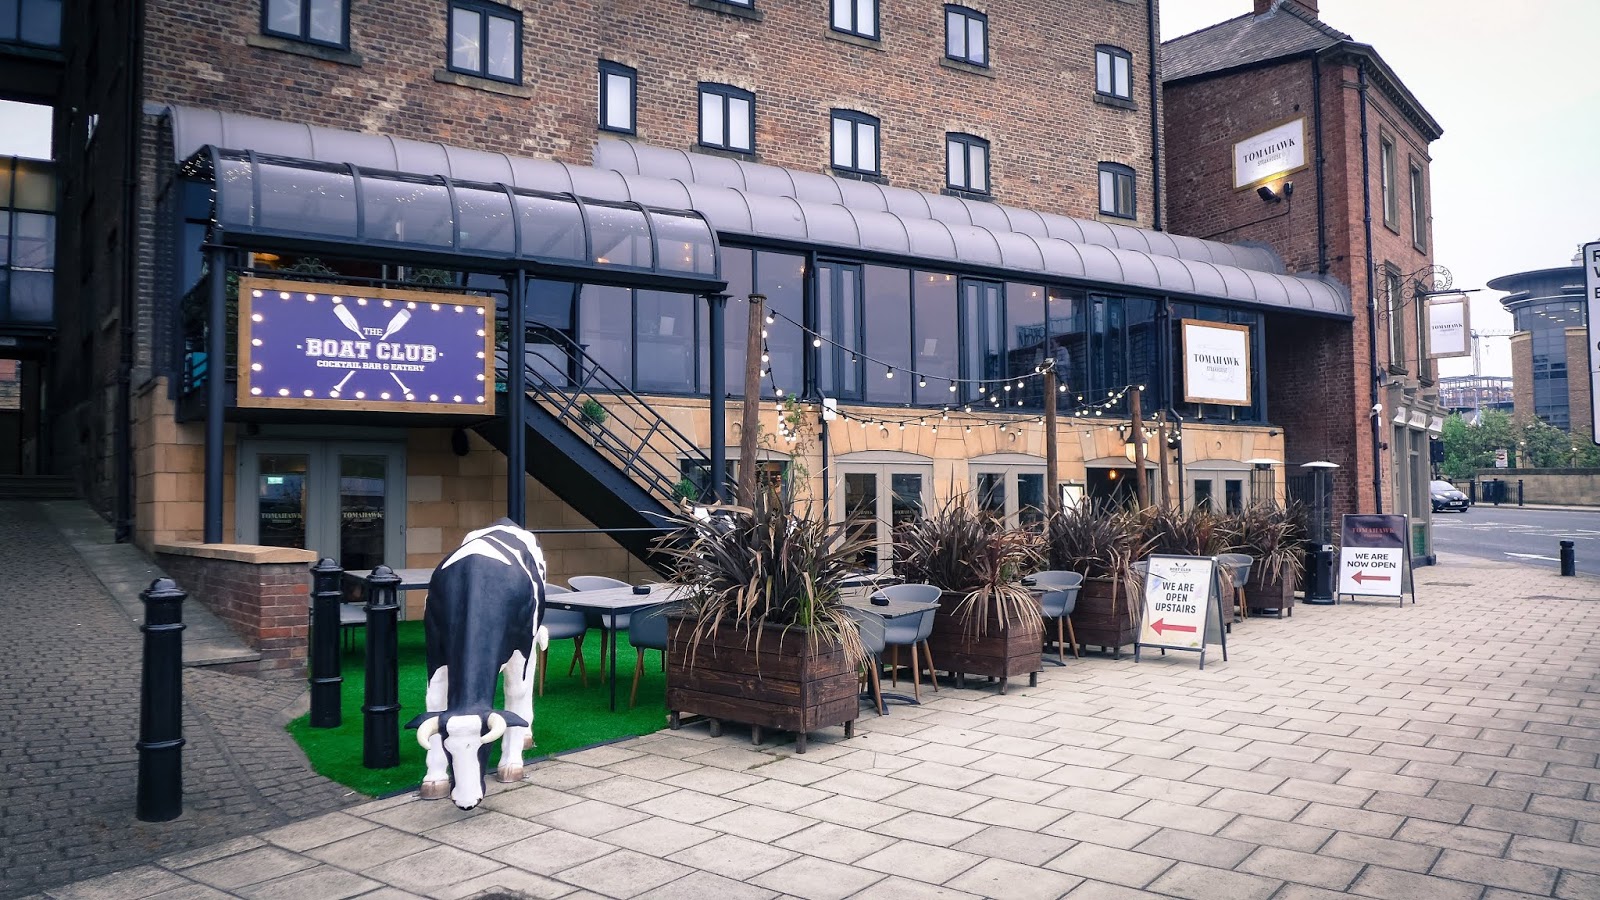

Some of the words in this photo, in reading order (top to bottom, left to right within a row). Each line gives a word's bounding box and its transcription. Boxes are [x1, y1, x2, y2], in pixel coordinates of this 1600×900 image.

[1243, 138, 1295, 163] TOMAHAWK
[362, 327, 383, 336] THE
[305, 338, 371, 359] BOAT
[376, 342, 437, 362] CLUB
[1194, 353, 1239, 366] TOMAHAWK
[316, 360, 361, 369] COCKTAIL
[362, 362, 381, 370] BAR
[391, 363, 425, 372] EATERY
[343, 511, 383, 519] TOMAHAWK
[1371, 561, 1396, 569] OPEN
[1162, 581, 1176, 591] WE
[1178, 583, 1194, 592] ARE
[1166, 592, 1188, 602] OPEN
[1155, 602, 1196, 614] UPSTAIRS
